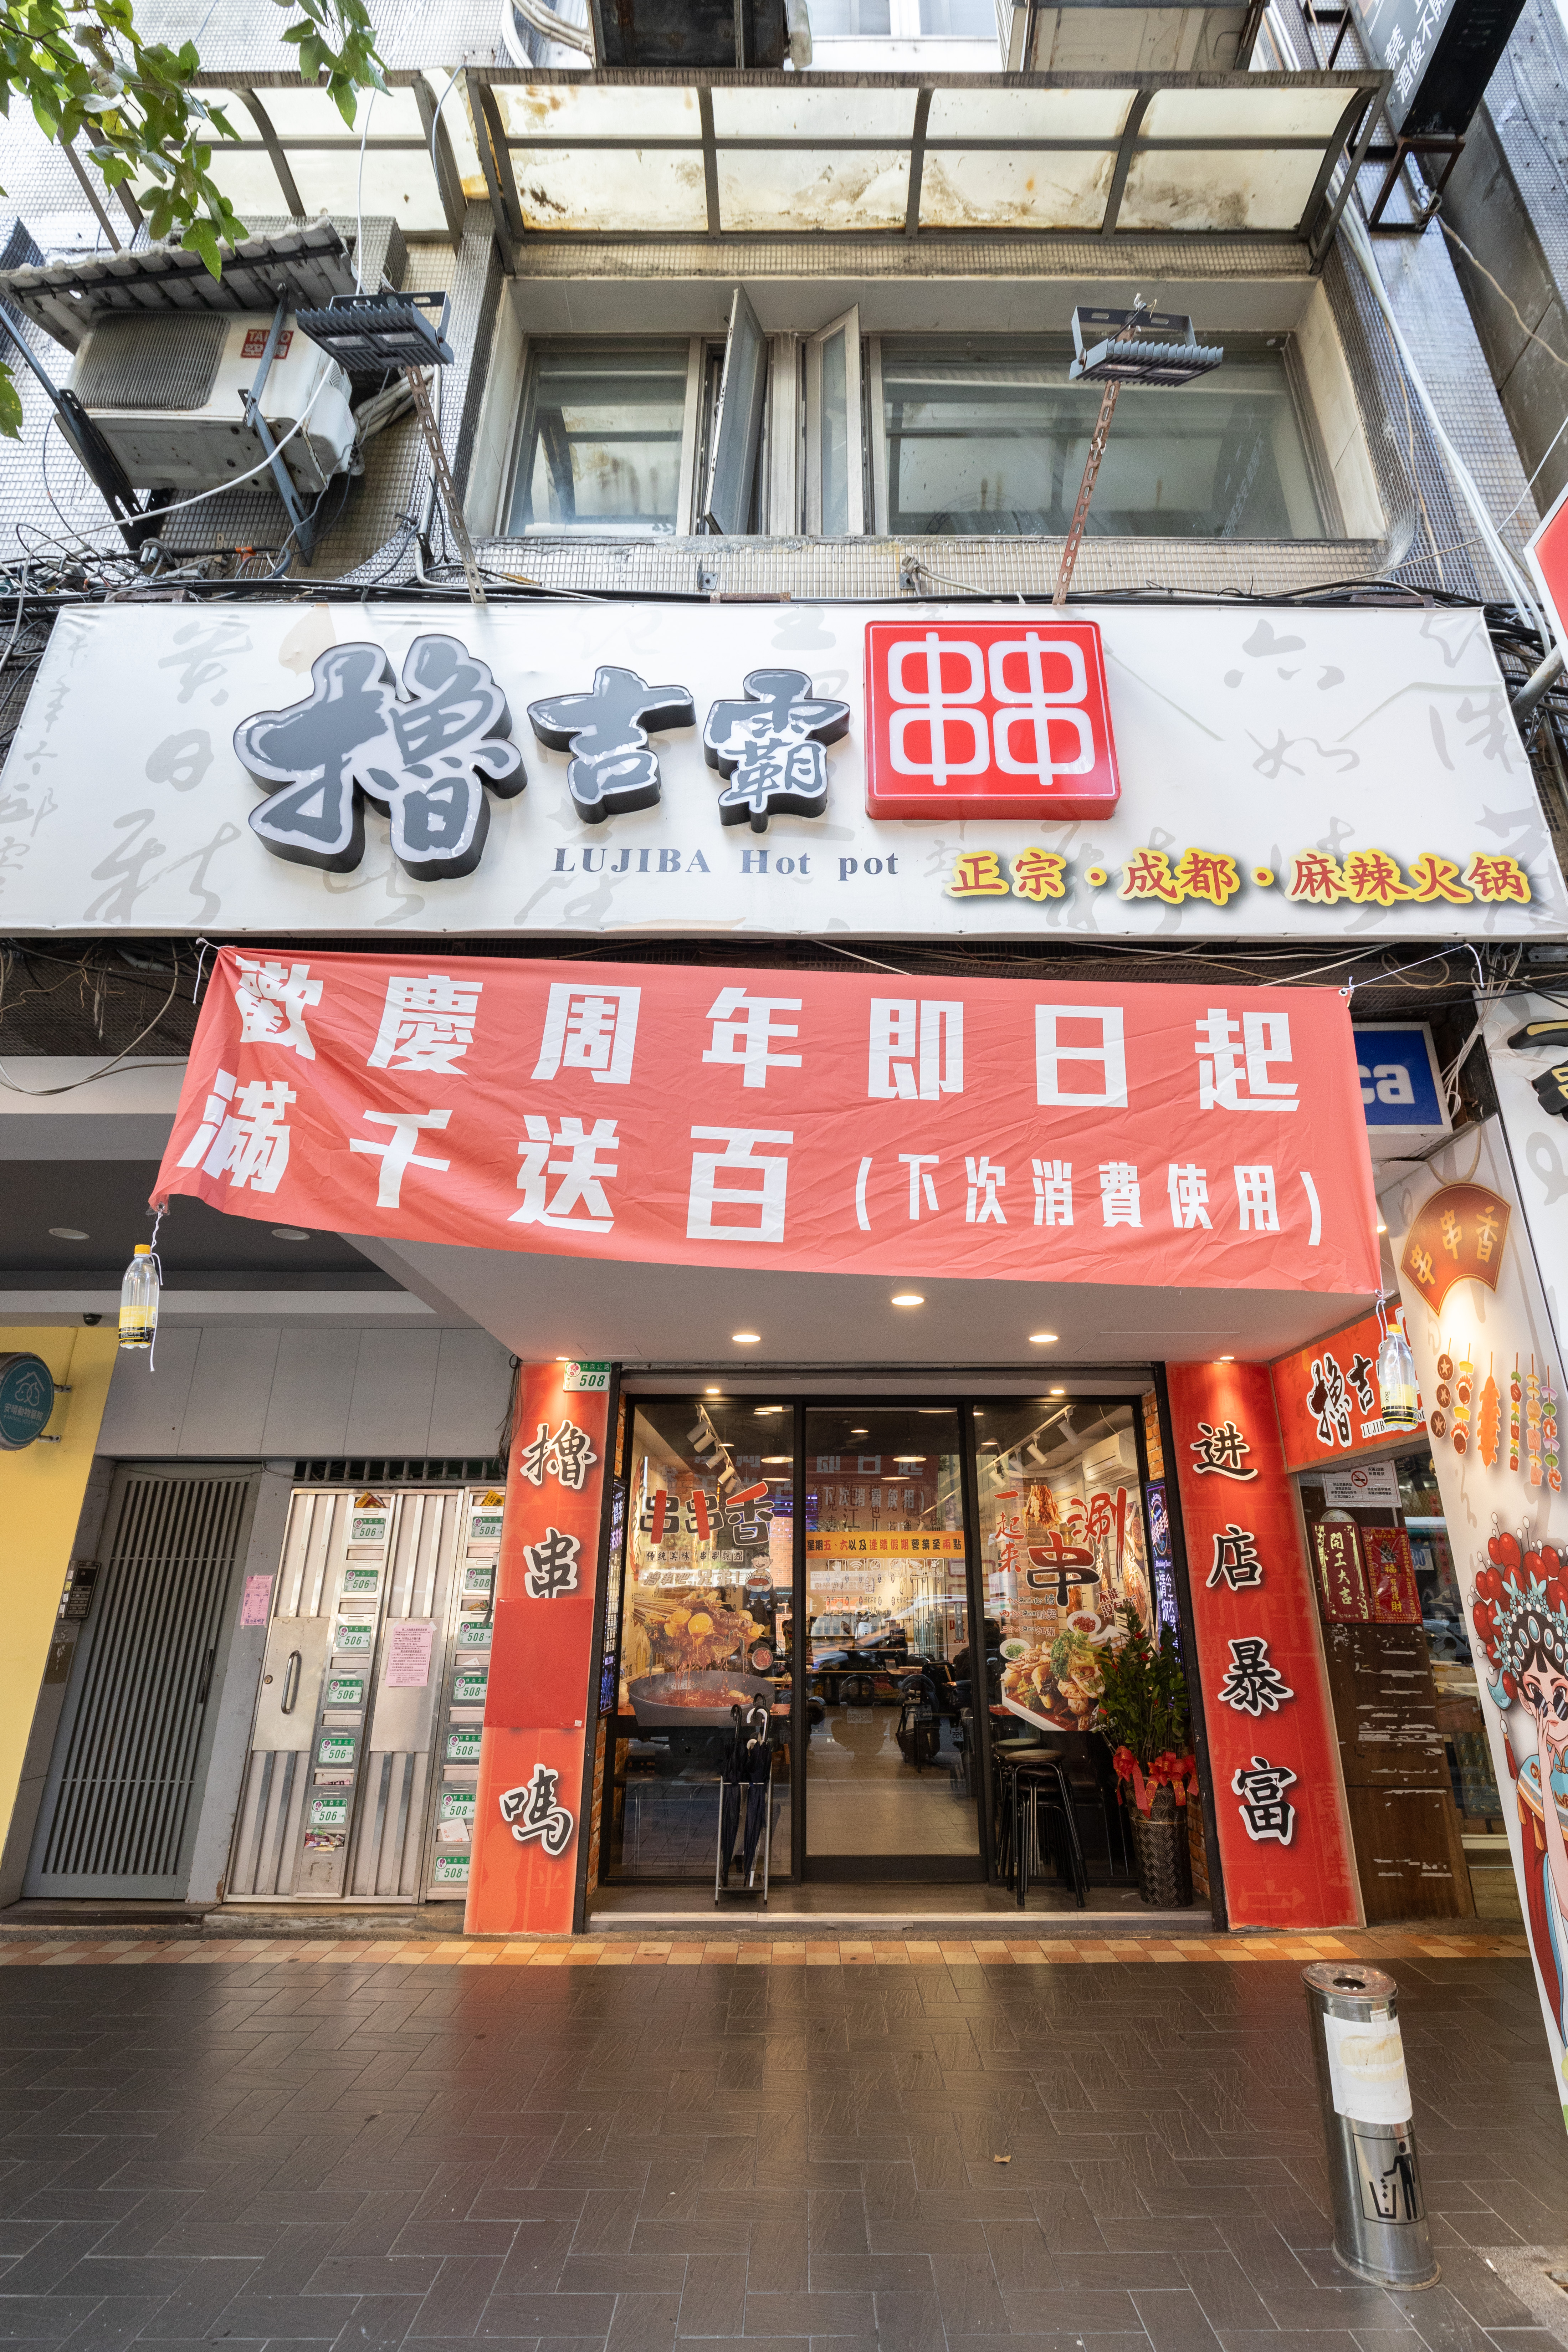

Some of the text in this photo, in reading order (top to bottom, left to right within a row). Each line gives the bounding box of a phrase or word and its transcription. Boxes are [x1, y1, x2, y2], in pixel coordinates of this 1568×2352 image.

[248, 331, 292, 343] TAIO
[552, 847, 899, 881] LUJIBA Hot pot
[235, 954, 1300, 1112] 歡慶周年即日起
[579, 1375, 605, 1387] 508
[1307, 1352, 1380, 1447] 擼吉
[1362, 1419, 1388, 1437] LUJIB
[640, 1481, 774, 1545] 串串香
[360, 1528, 376, 1536] 506
[994, 1490, 1025, 1573] 一起来
[806, 1538, 962, 1551] 星期五、六以及連續假期營業至兩點
[646, 1551, 690, 1561] 传统美味
[1330, 1532, 1353, 1605] 開工大吉
[353, 1580, 370, 1588] 506
[467, 1633, 484, 1641] 508
[499, 1420, 598, 1856] 擼串嗎
[1190, 1420, 1297, 1845] 进店暴富
[345, 1636, 362, 1645] 506
[337, 1690, 354, 1699] 506
[463, 1687, 481, 1696] 508
[329, 1749, 347, 1758] 506
[456, 1746, 473, 1755] 508
[319, 1811, 337, 1821] 506
[450, 1806, 467, 1815] 508
[444, 1868, 462, 1878] 508
